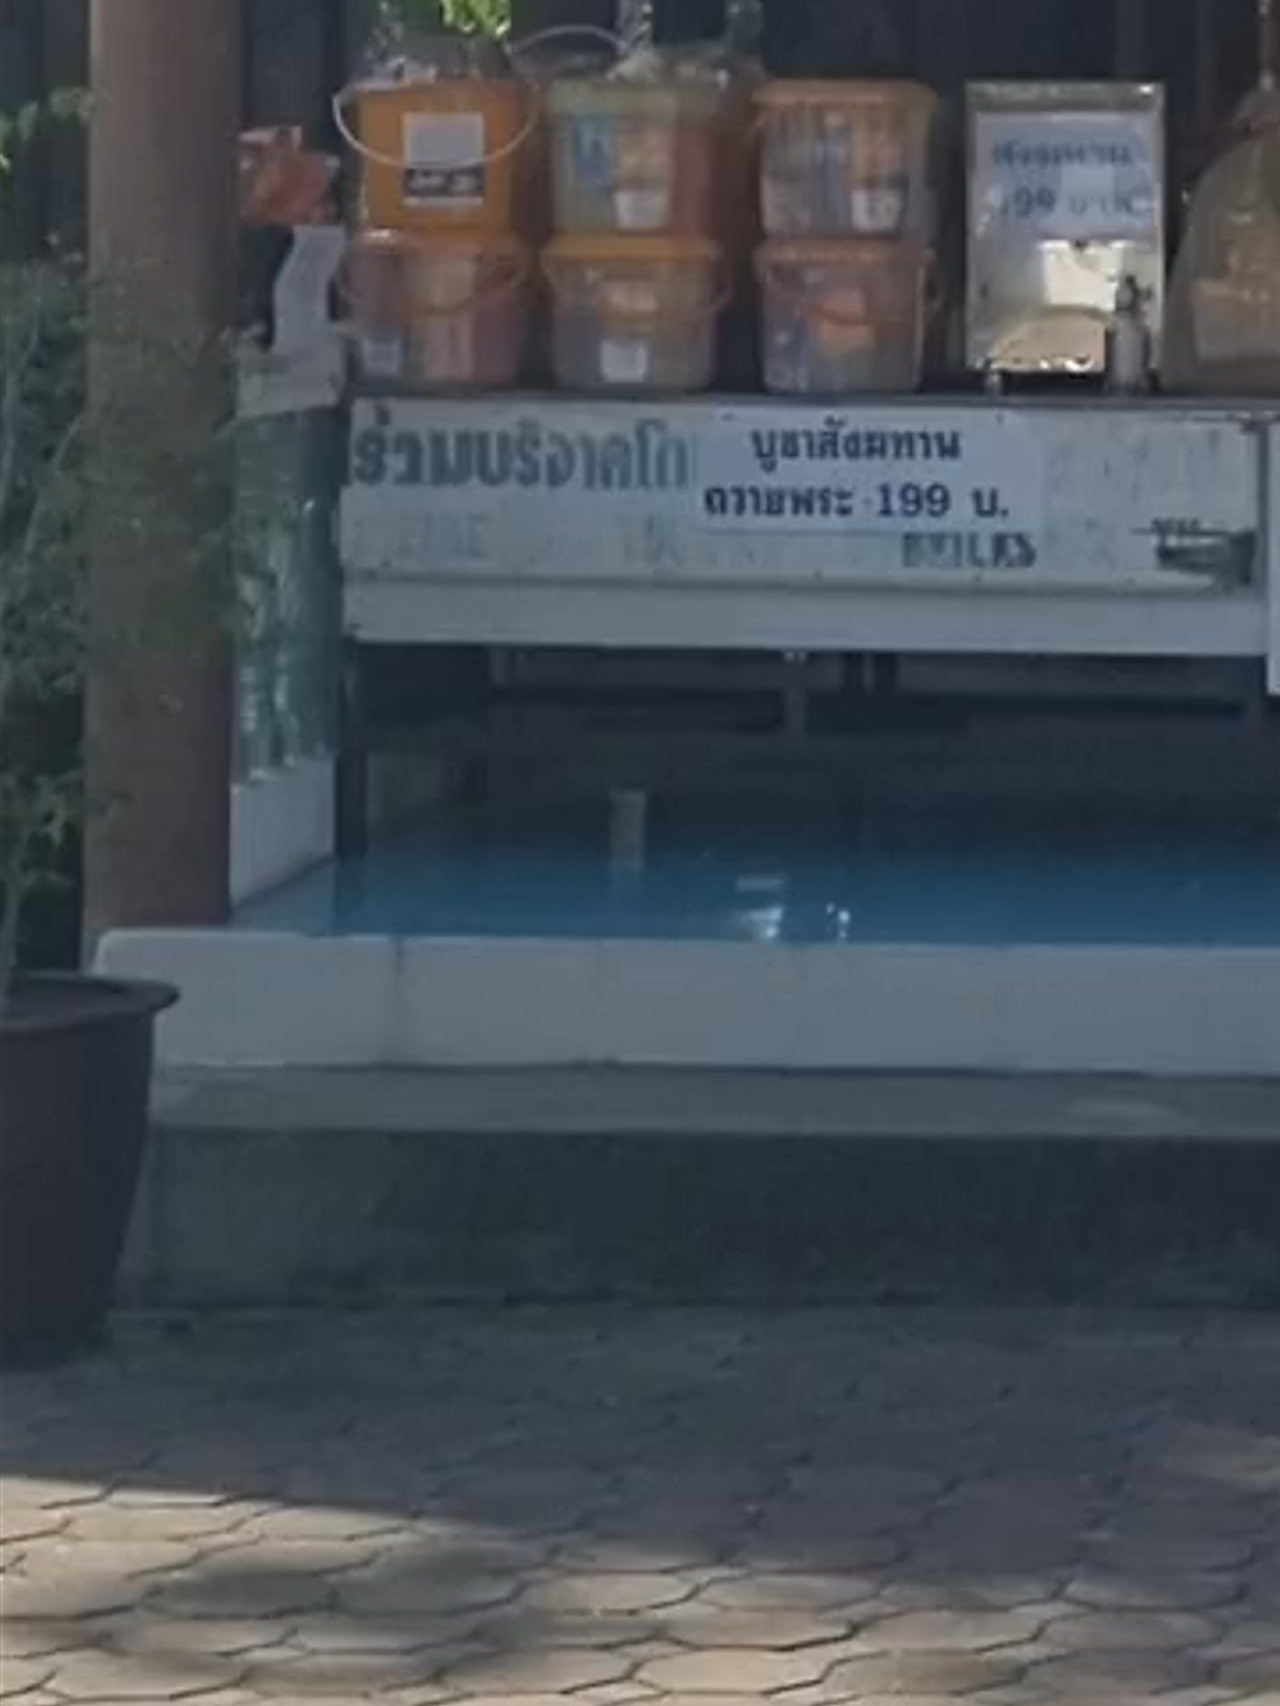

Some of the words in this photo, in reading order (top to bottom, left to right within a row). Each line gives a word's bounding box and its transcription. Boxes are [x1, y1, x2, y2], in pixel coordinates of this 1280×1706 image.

[703, 484, 854, 518] ถวายพระ
[877, 482, 951, 518] 199
